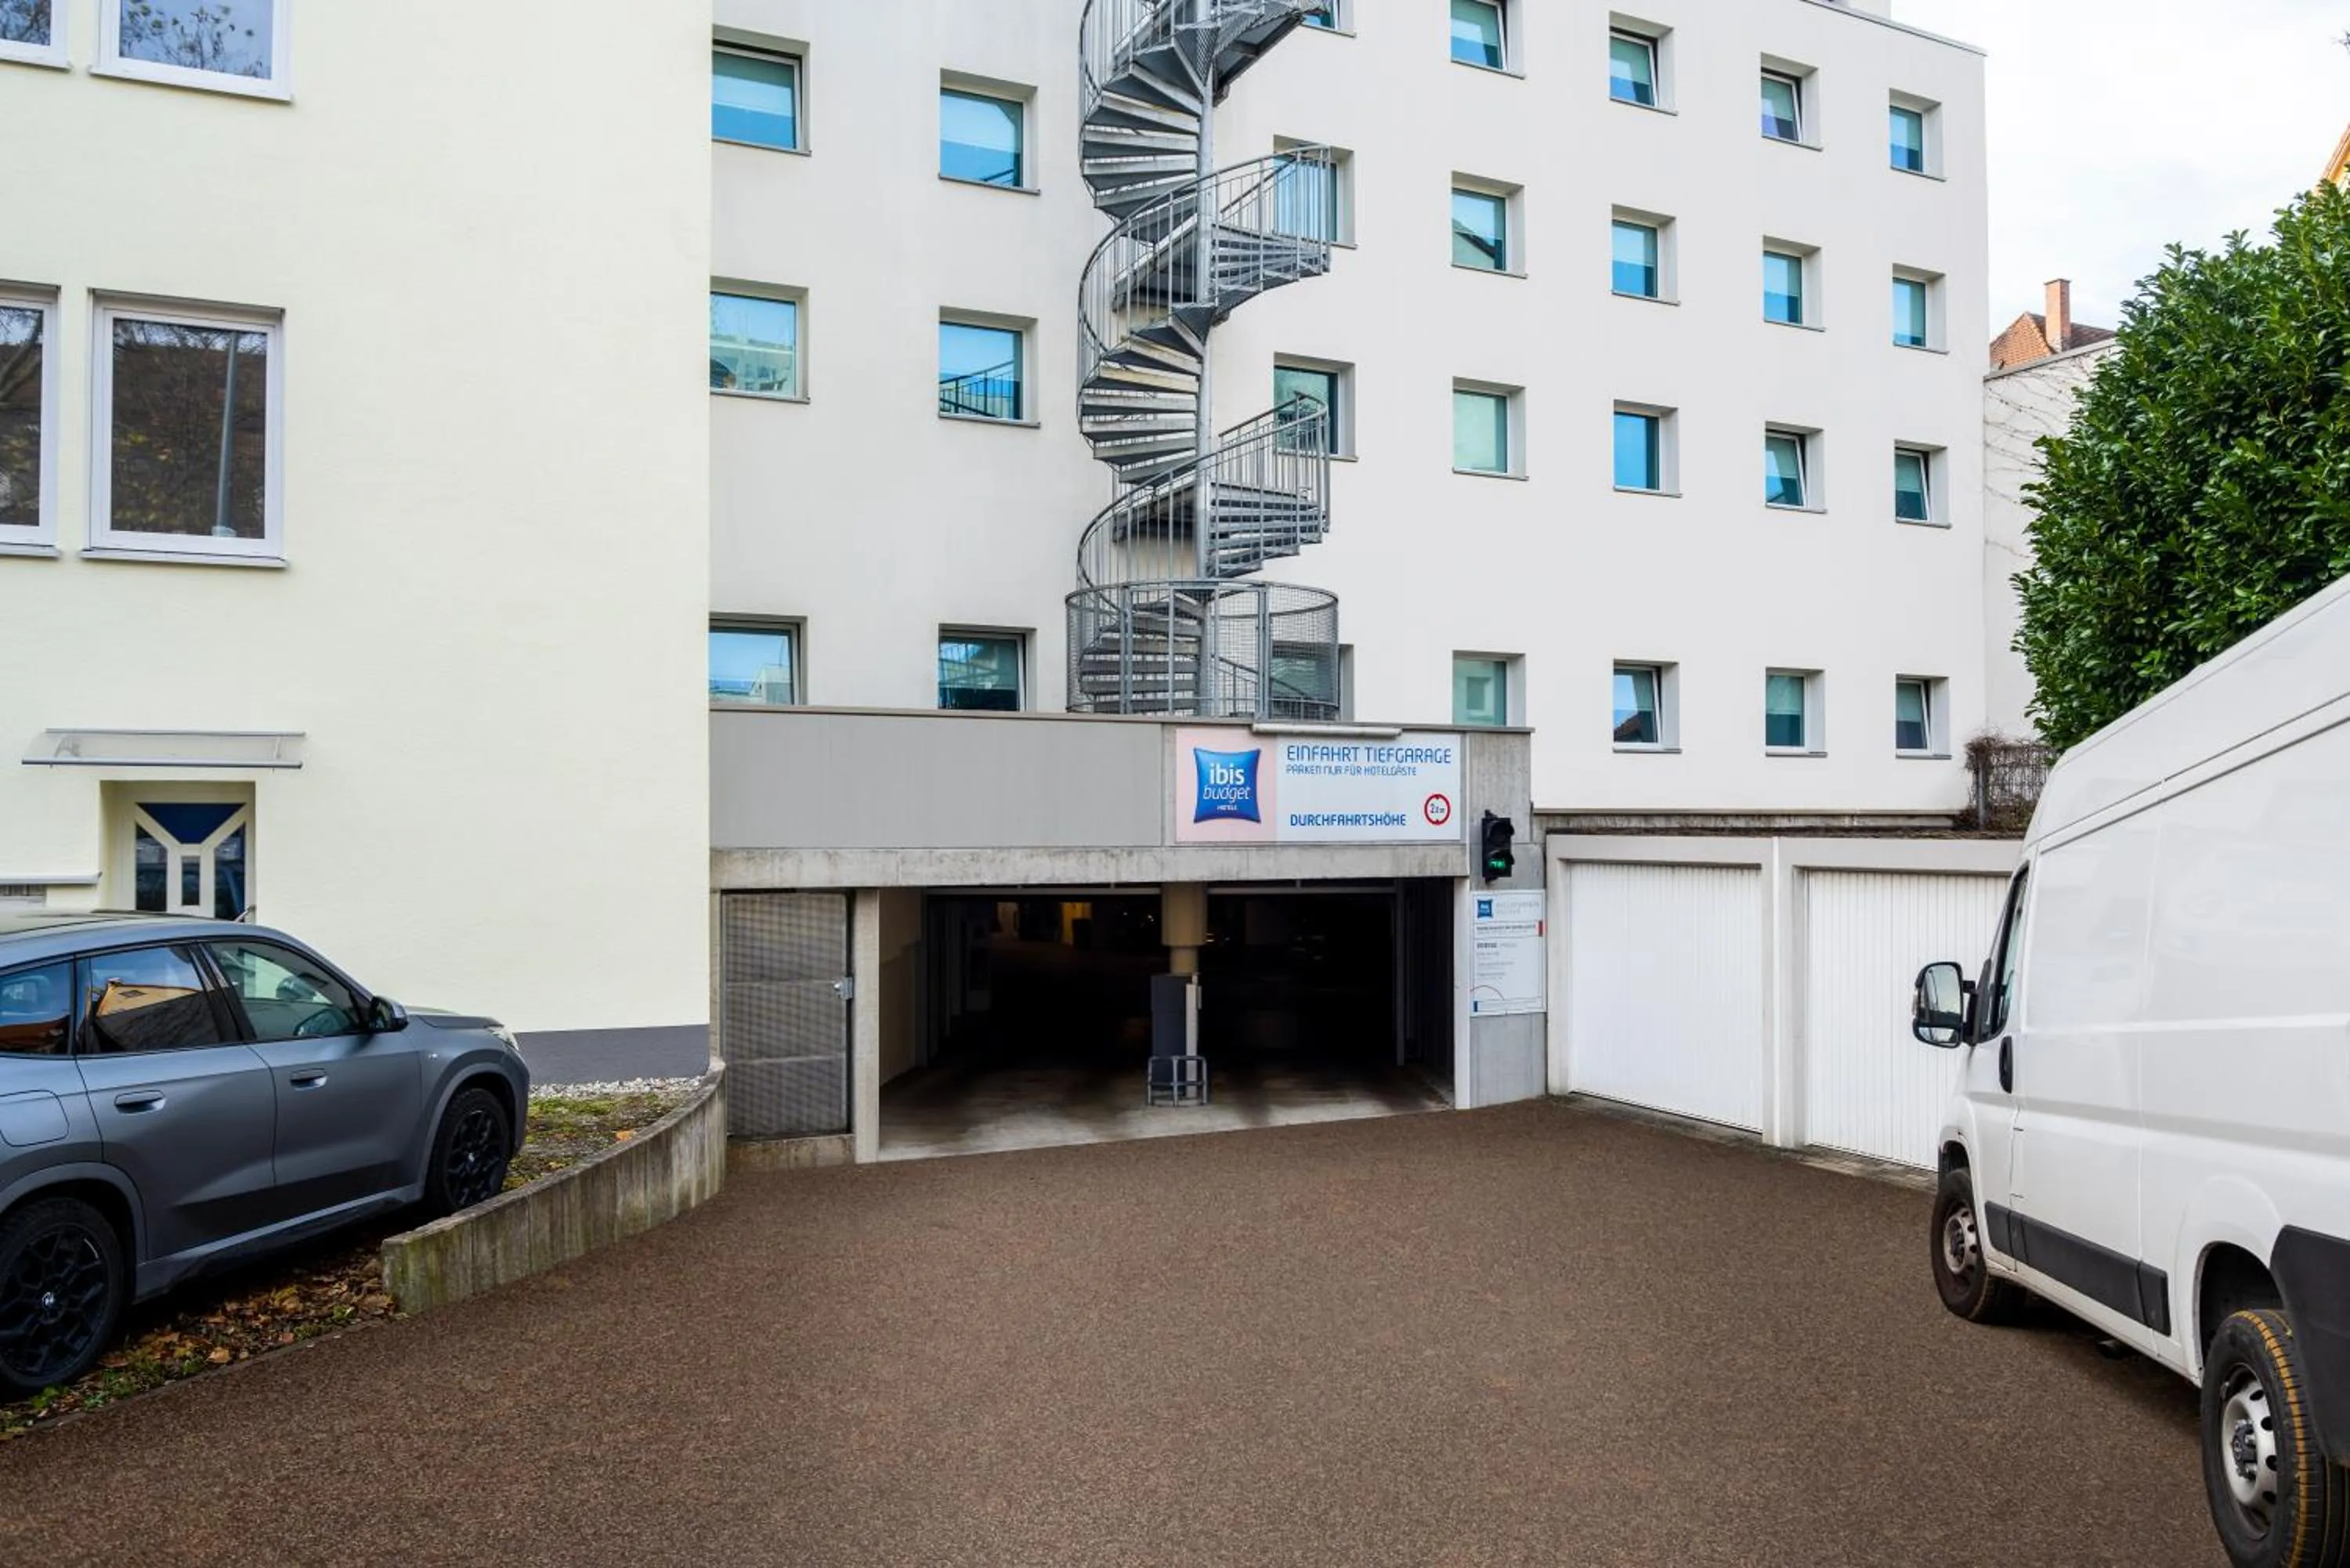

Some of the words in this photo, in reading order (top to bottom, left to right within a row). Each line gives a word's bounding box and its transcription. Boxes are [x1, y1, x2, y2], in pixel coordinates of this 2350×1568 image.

[1287, 745, 1360, 762] EINFAHRT
[1365, 746, 1452, 764] TIEFGARAGE
[1209, 763, 1245, 785] ibis
[1285, 764, 1321, 775] PARKEN
[1323, 765, 1342, 775] NUR
[1344, 764, 1362, 775] FÜR
[1364, 765, 1416, 776] HOTELGÄSTE
[1203, 784, 1250, 803] budget
[1290, 811, 1406, 826] DURCHFAHRTSHÖHE
